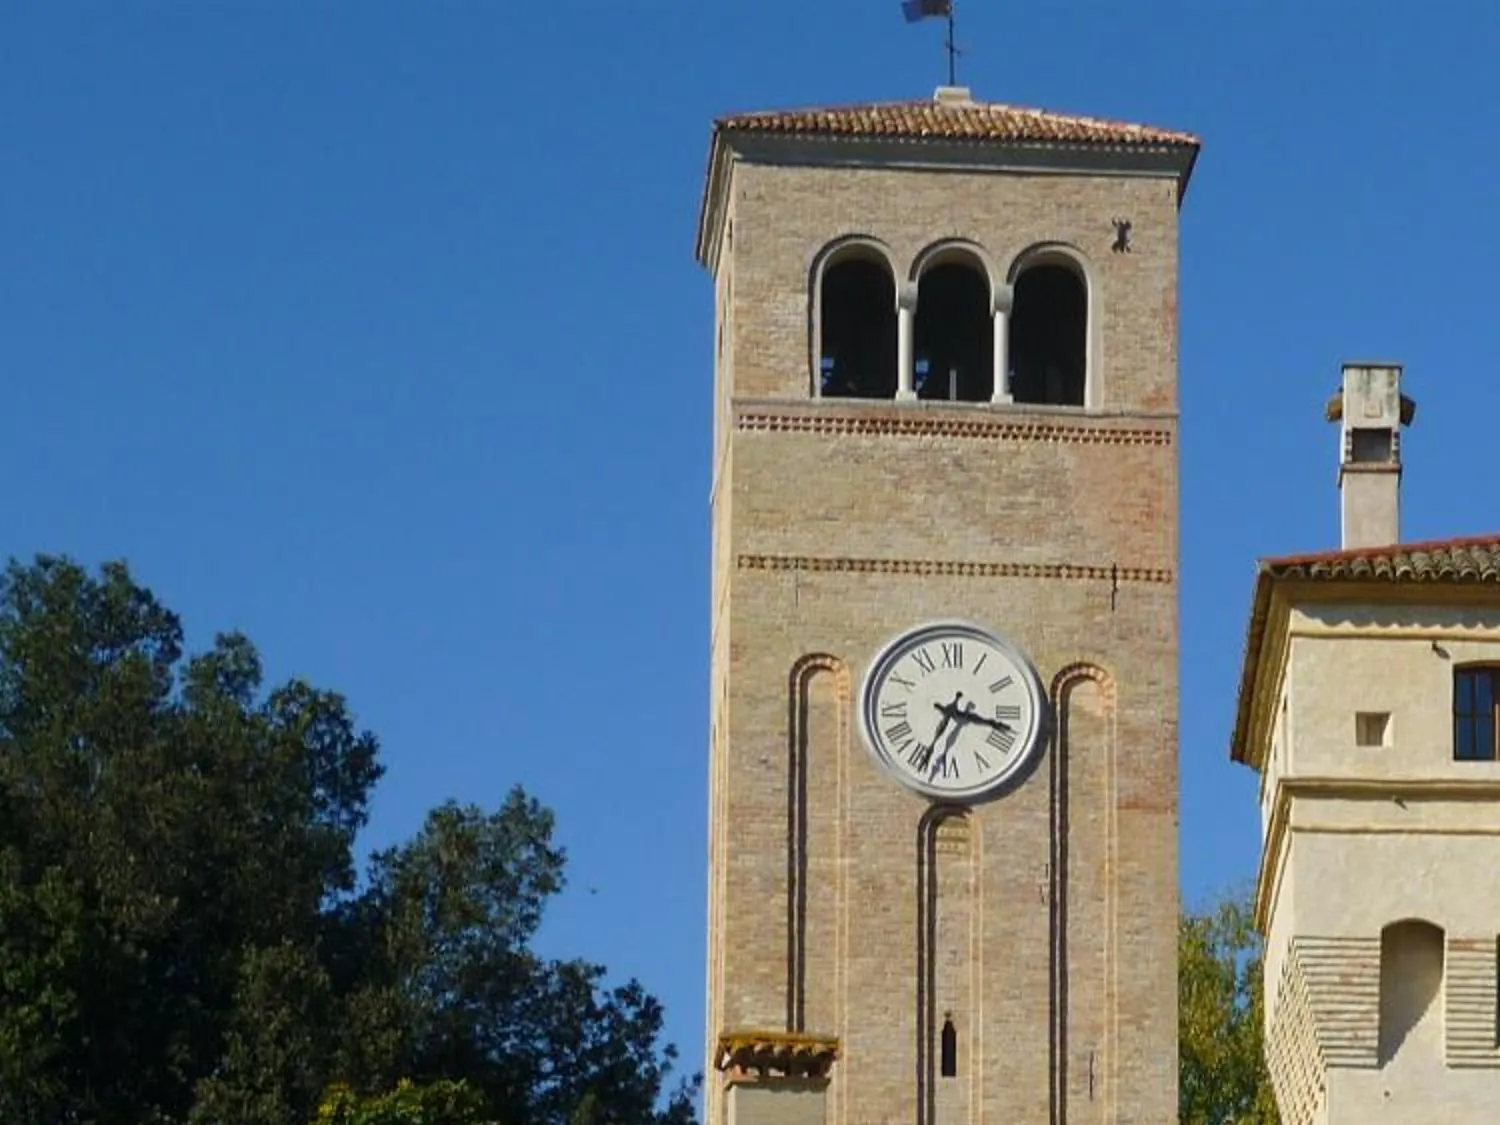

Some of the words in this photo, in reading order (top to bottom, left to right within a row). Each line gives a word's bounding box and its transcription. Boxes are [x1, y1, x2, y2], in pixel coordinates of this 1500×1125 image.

[911, 647, 936, 678] XI
[941, 642, 963, 669] XII
[972, 652, 987, 675] I
[889, 671, 916, 694] X
[988, 675, 1014, 694] II
[881, 701, 907, 718] IX
[995, 705, 1020, 720] III
[973, 751, 991, 774] V
